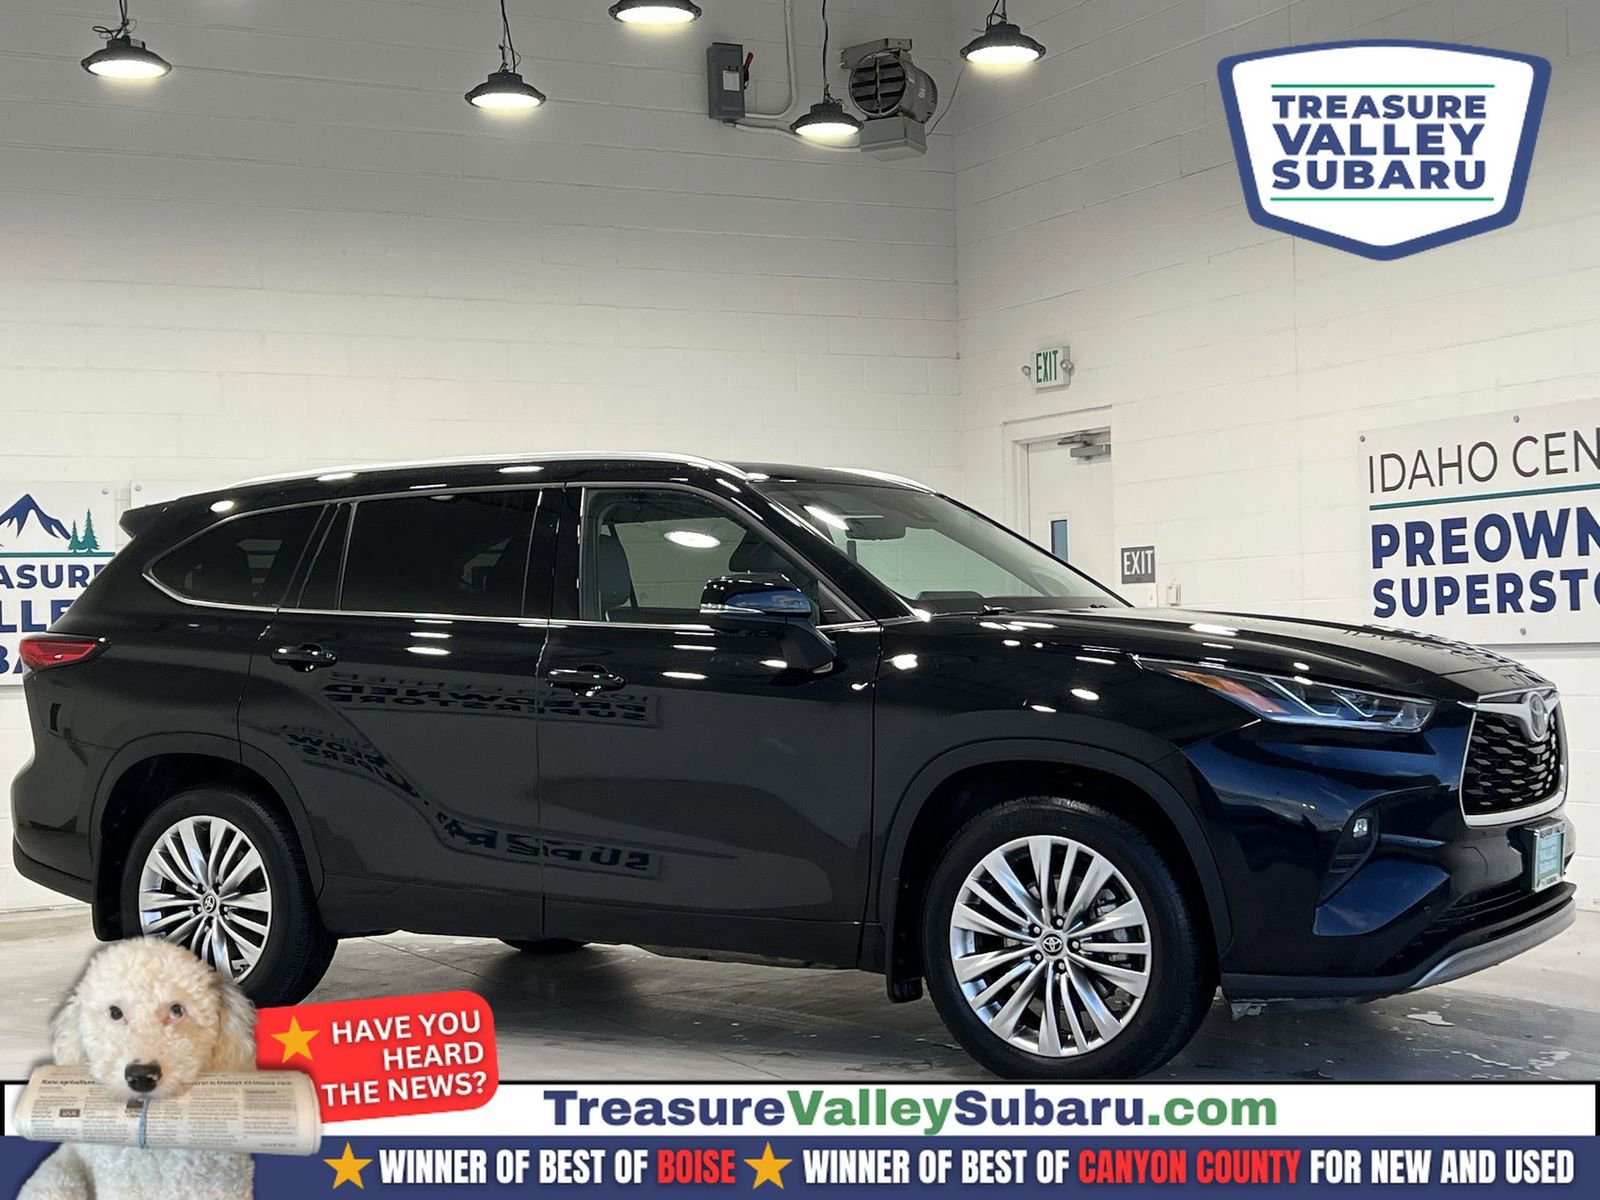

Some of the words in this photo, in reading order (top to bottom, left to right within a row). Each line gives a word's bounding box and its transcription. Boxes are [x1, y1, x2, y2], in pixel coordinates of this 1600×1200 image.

[1036, 350, 1058, 383] EXIT
[1369, 441, 1498, 494] IDAHO
[1512, 427, 1600, 478] CEN
[1371, 506, 1600, 569] PREOWN
[1123, 550, 1154, 576] EXIT
[1373, 568, 1600, 618] SUPERST
